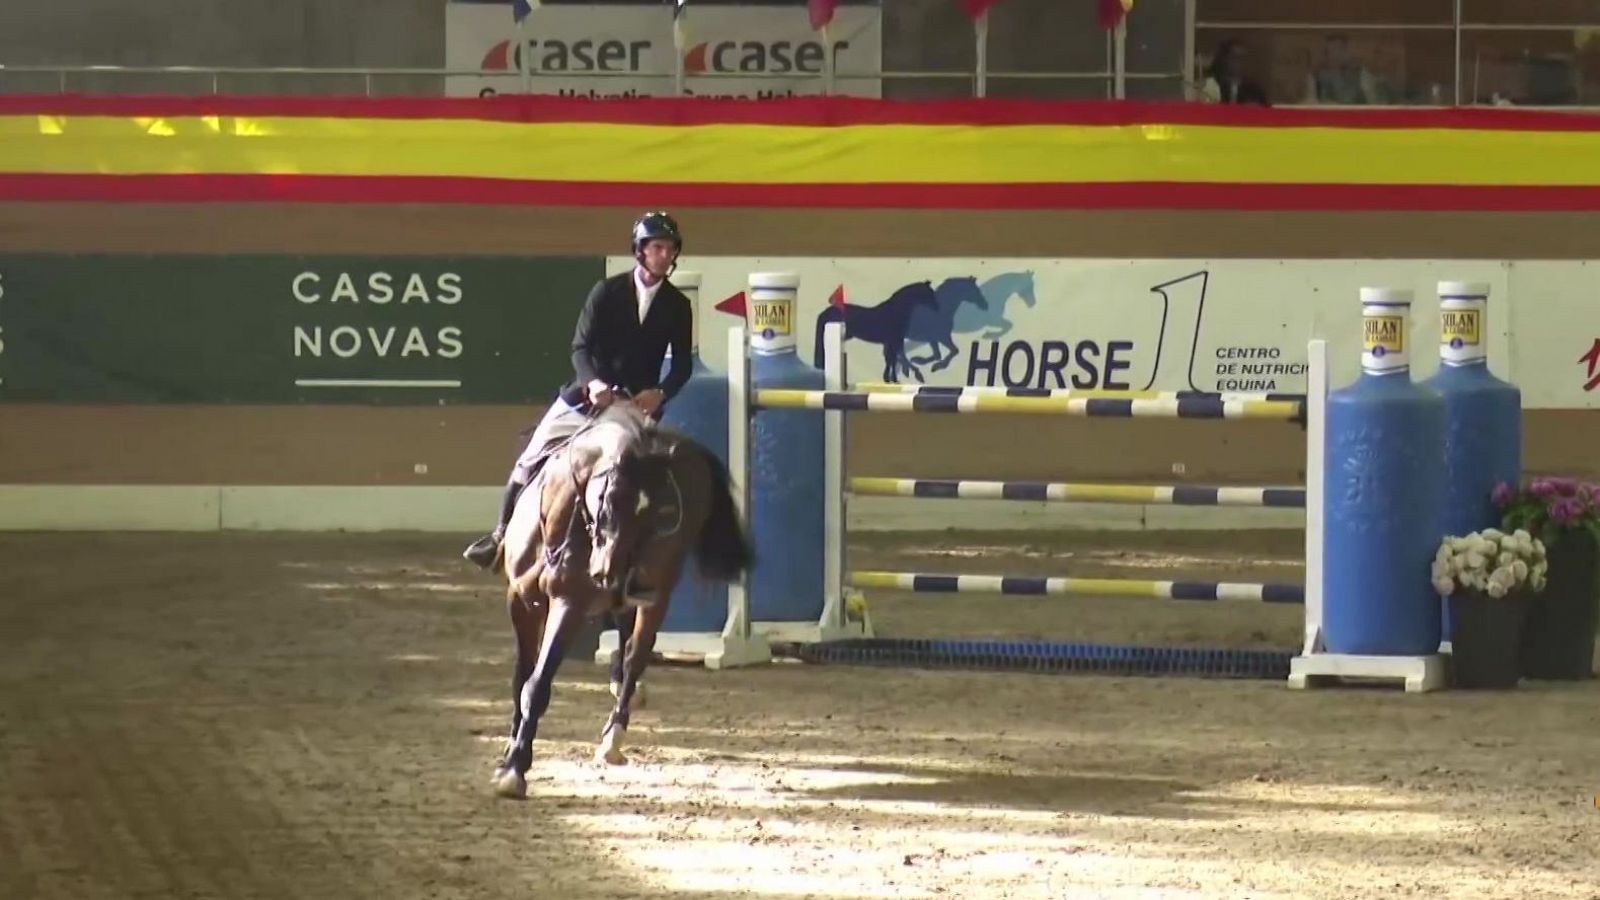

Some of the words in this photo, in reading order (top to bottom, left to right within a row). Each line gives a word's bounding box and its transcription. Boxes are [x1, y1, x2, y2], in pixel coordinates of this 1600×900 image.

[514, 40, 652, 72] caser
[712, 40, 849, 73] caser
[292, 271, 463, 304] CASAS
[293, 325, 463, 358] NOVAS
[1216, 347, 1281, 359] CENTRO
[967, 340, 1134, 391] HORSE
[1216, 363, 1238, 375] DE
[1241, 363, 1309, 375] NUTRICI
[1216, 379, 1277, 391] EQUINA
